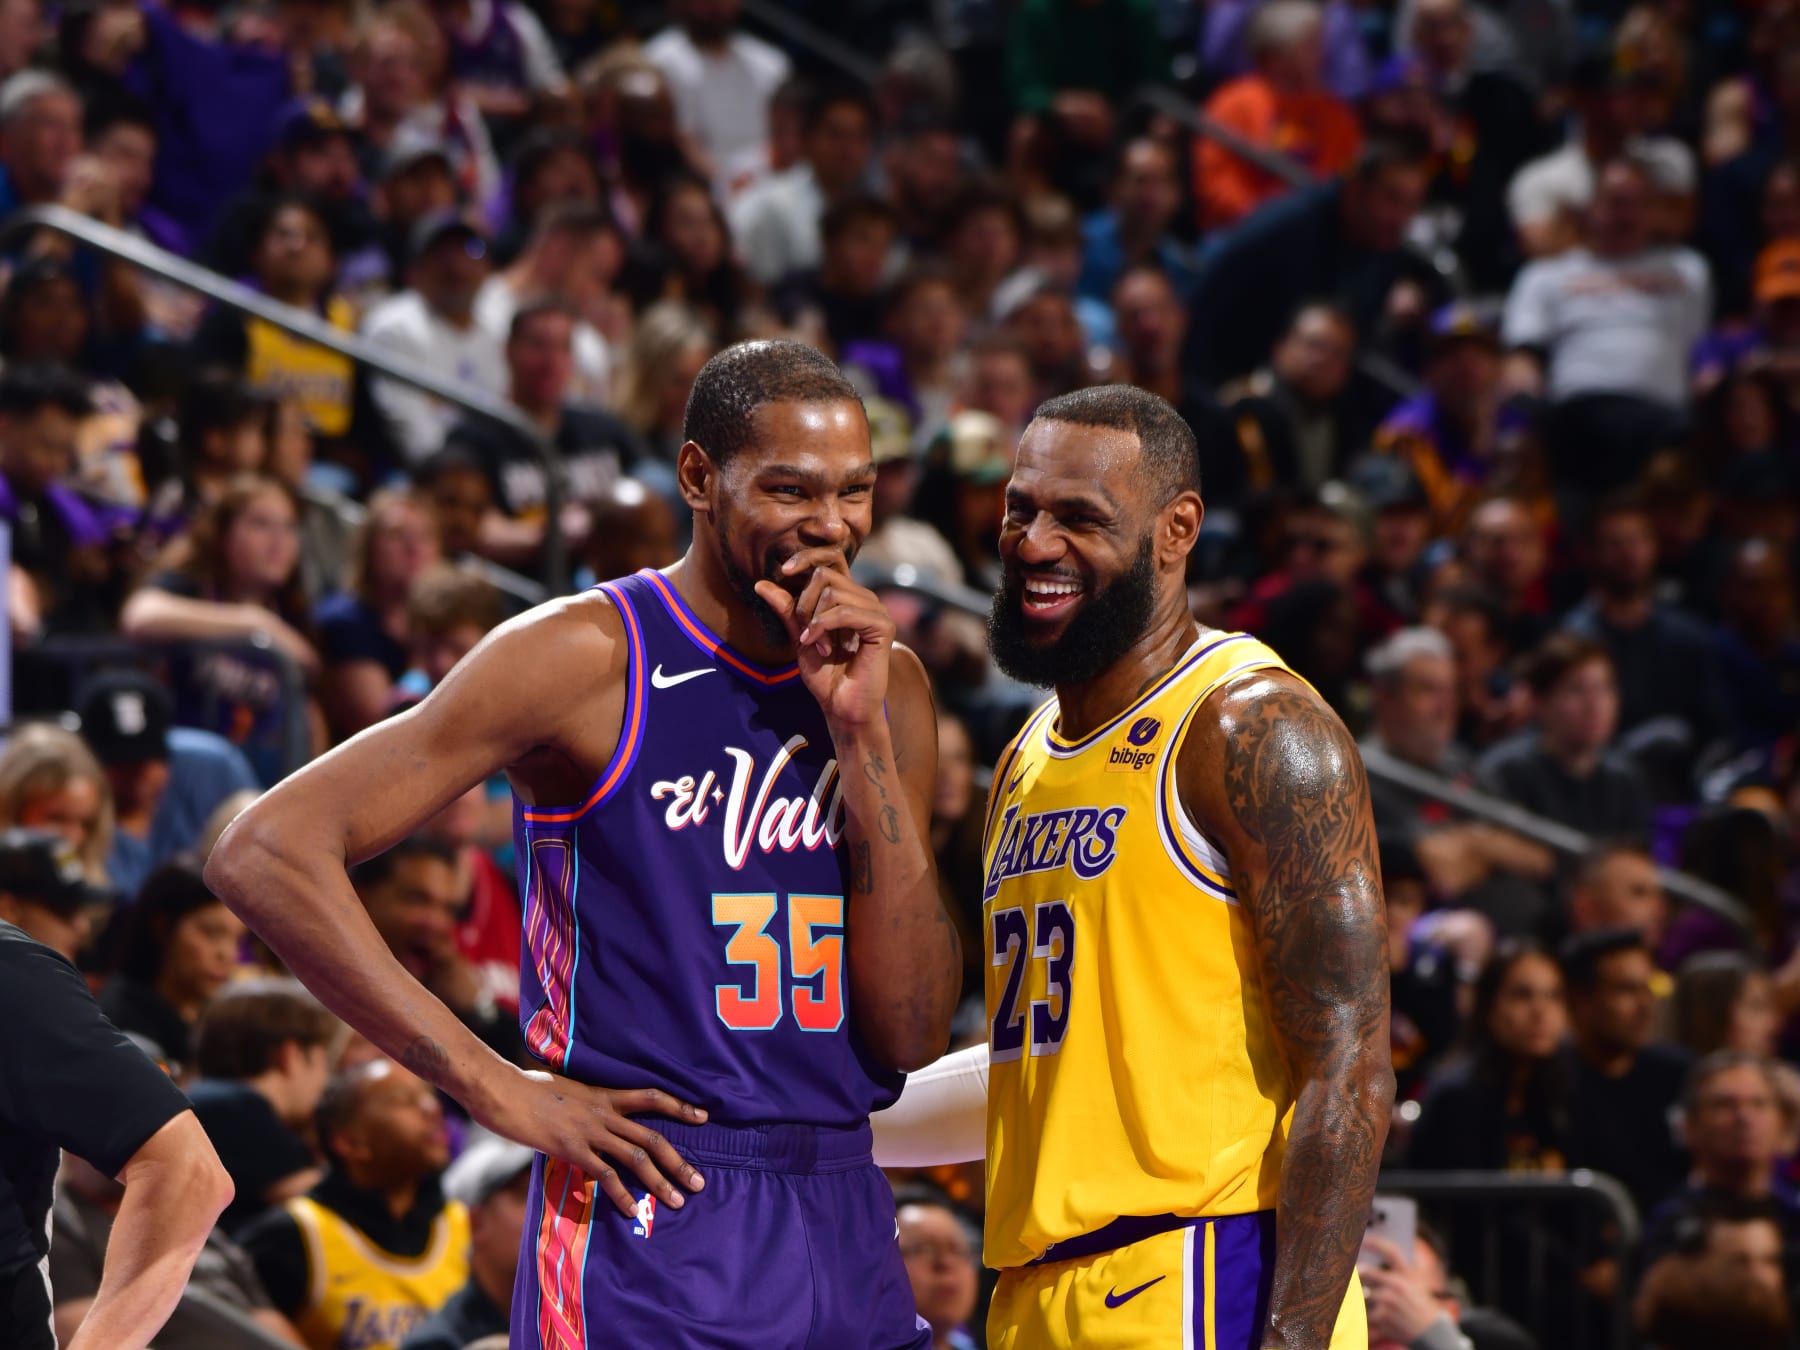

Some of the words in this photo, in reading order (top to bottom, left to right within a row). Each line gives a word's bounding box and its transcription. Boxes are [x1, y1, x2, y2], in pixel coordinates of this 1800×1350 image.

[650, 770, 716, 831] El
[1109, 746, 1156, 770] bibigo
[983, 803, 1128, 905] LAKERS
[711, 892, 845, 1033] 35
[990, 899, 1076, 1064] 23
